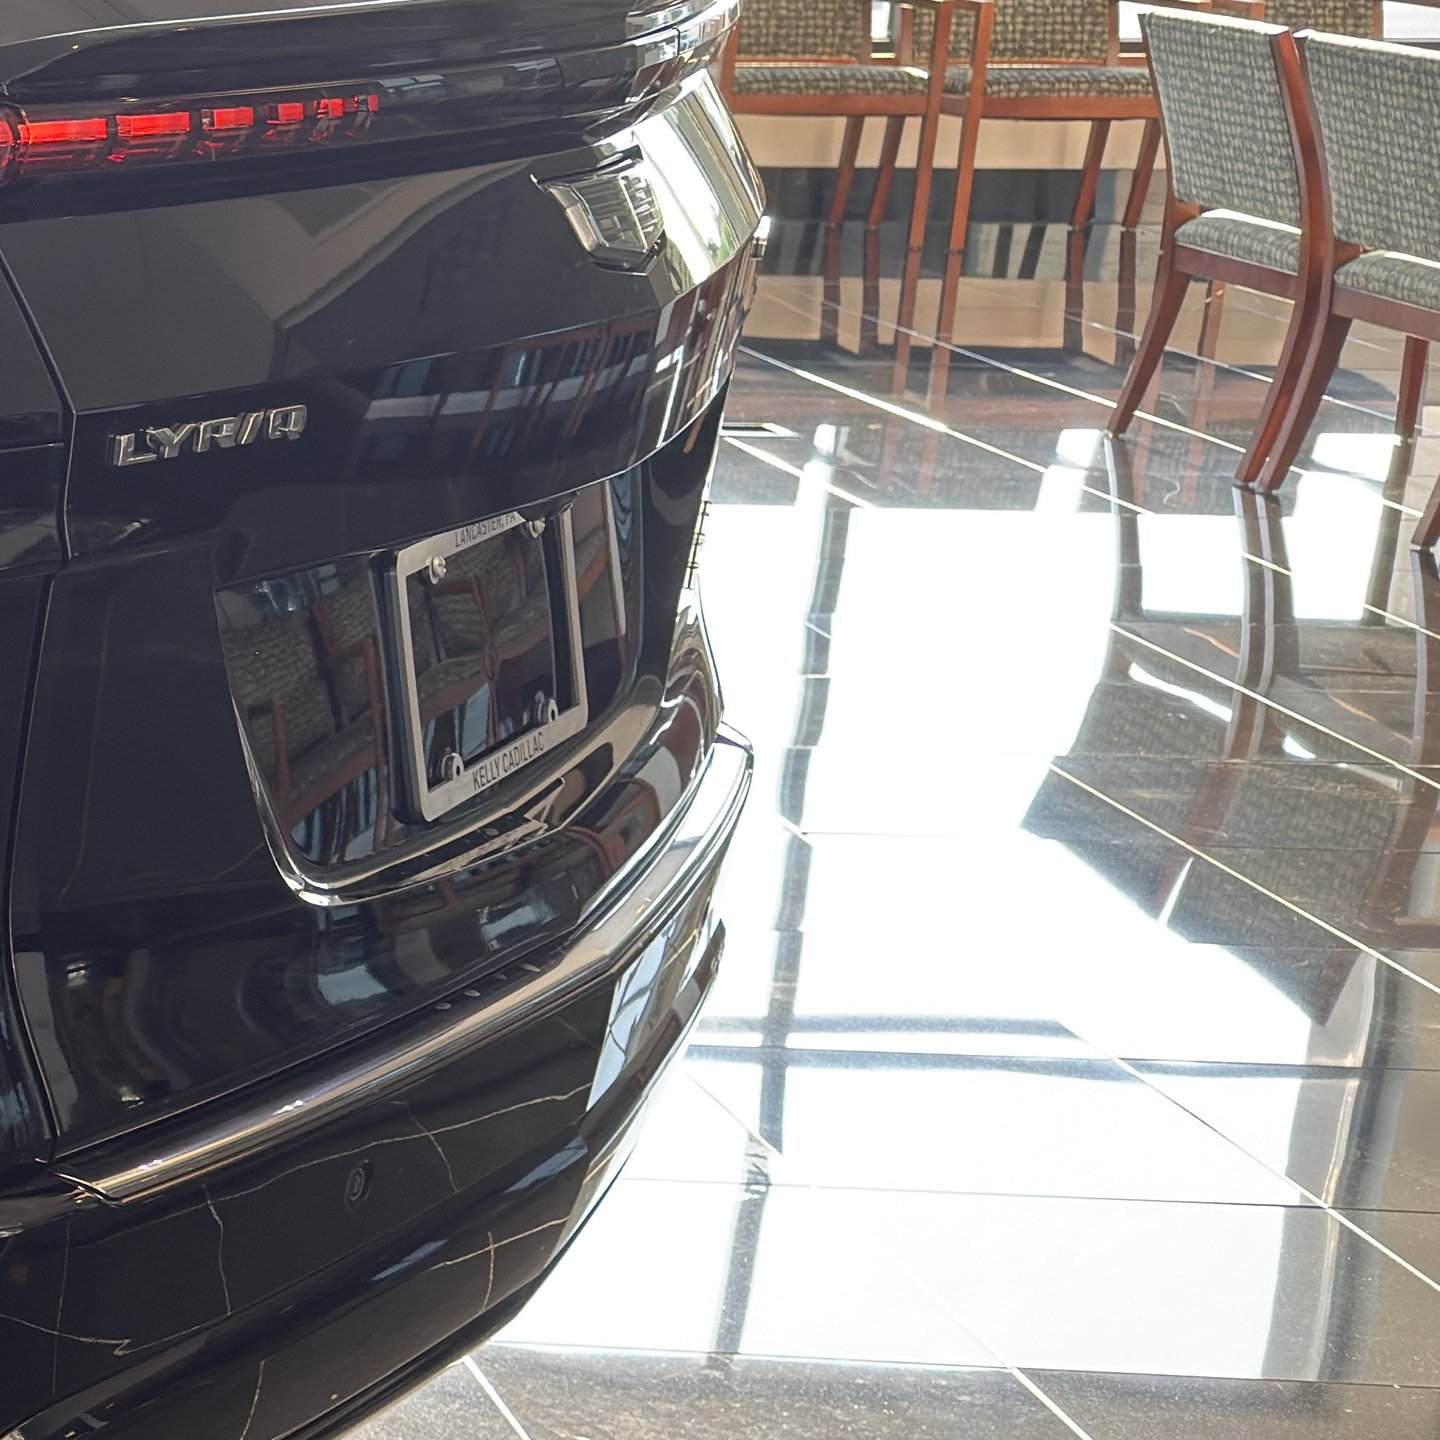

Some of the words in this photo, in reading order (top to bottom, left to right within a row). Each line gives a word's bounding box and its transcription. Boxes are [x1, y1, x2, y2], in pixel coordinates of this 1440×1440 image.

[112, 405, 308, 466] LYRIQ
[472, 757, 501, 791] KELLY
[502, 732, 544, 774] CADILLAC
